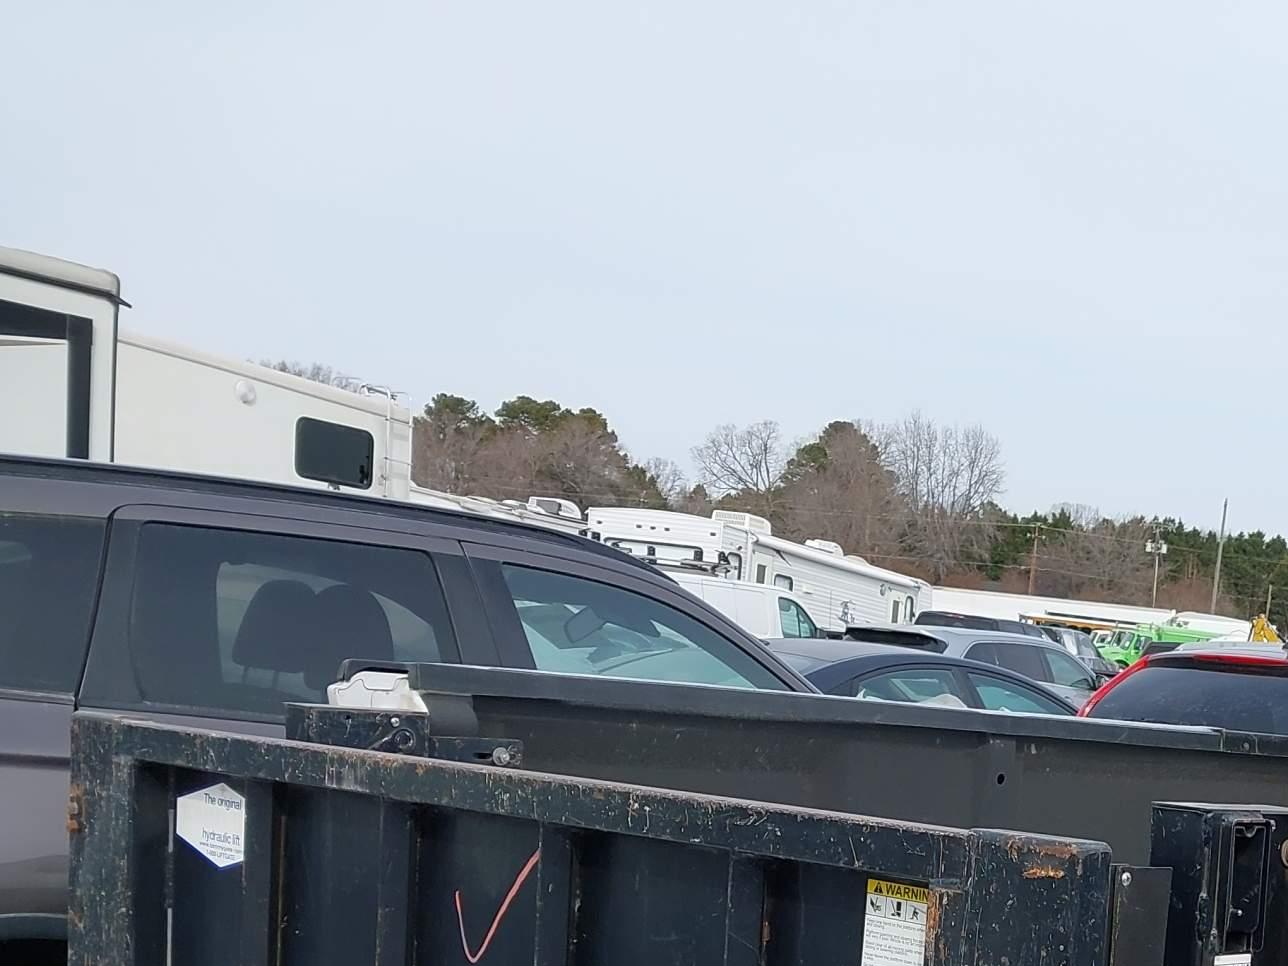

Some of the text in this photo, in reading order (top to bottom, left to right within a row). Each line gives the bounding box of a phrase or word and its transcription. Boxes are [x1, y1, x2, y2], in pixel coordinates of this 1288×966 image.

[204, 792, 242, 811] The original
[202, 827, 241, 847] hydraulic lift
[885, 883, 929, 902] WARNIN
